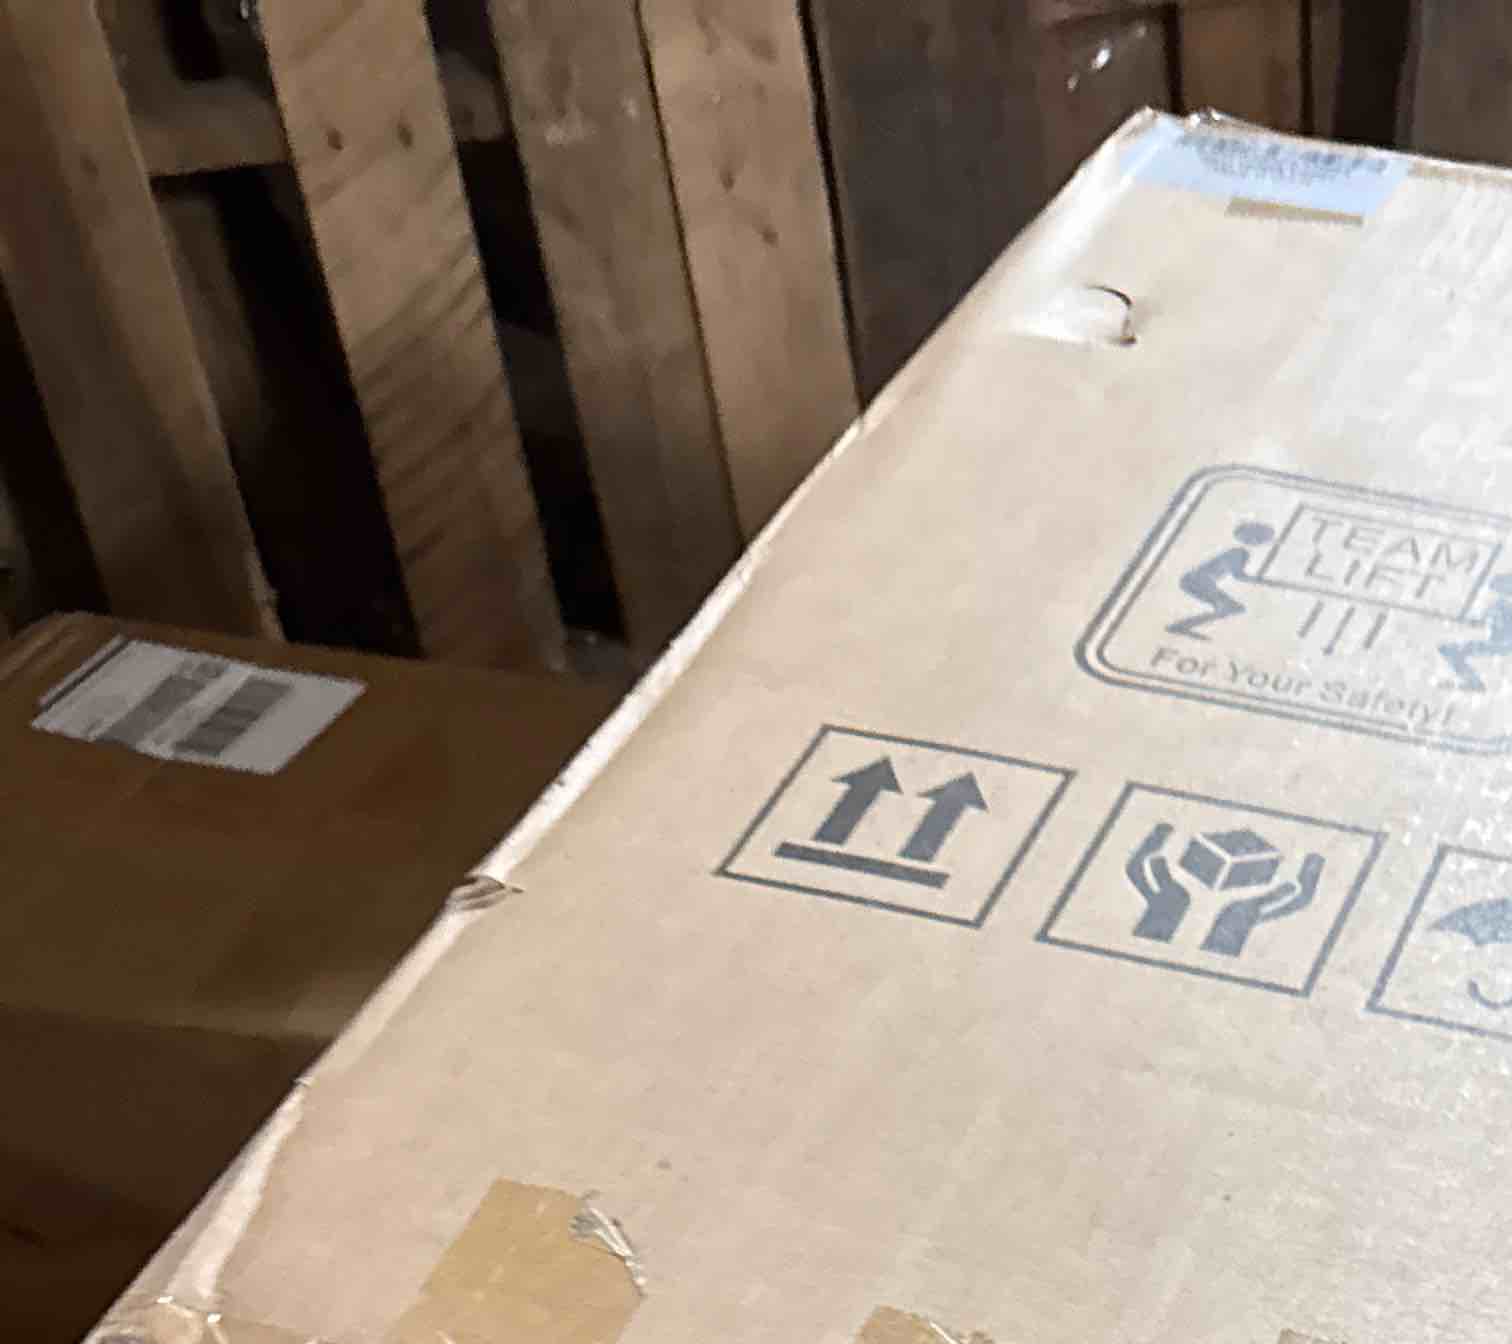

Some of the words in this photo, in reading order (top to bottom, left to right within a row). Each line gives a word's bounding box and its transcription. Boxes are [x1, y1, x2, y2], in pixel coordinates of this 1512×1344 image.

[1311, 516, 1480, 574] TEAM
[1304, 551, 1447, 599] LIFT
[1149, 647, 1213, 677] For
[1228, 660, 1312, 697] Your
